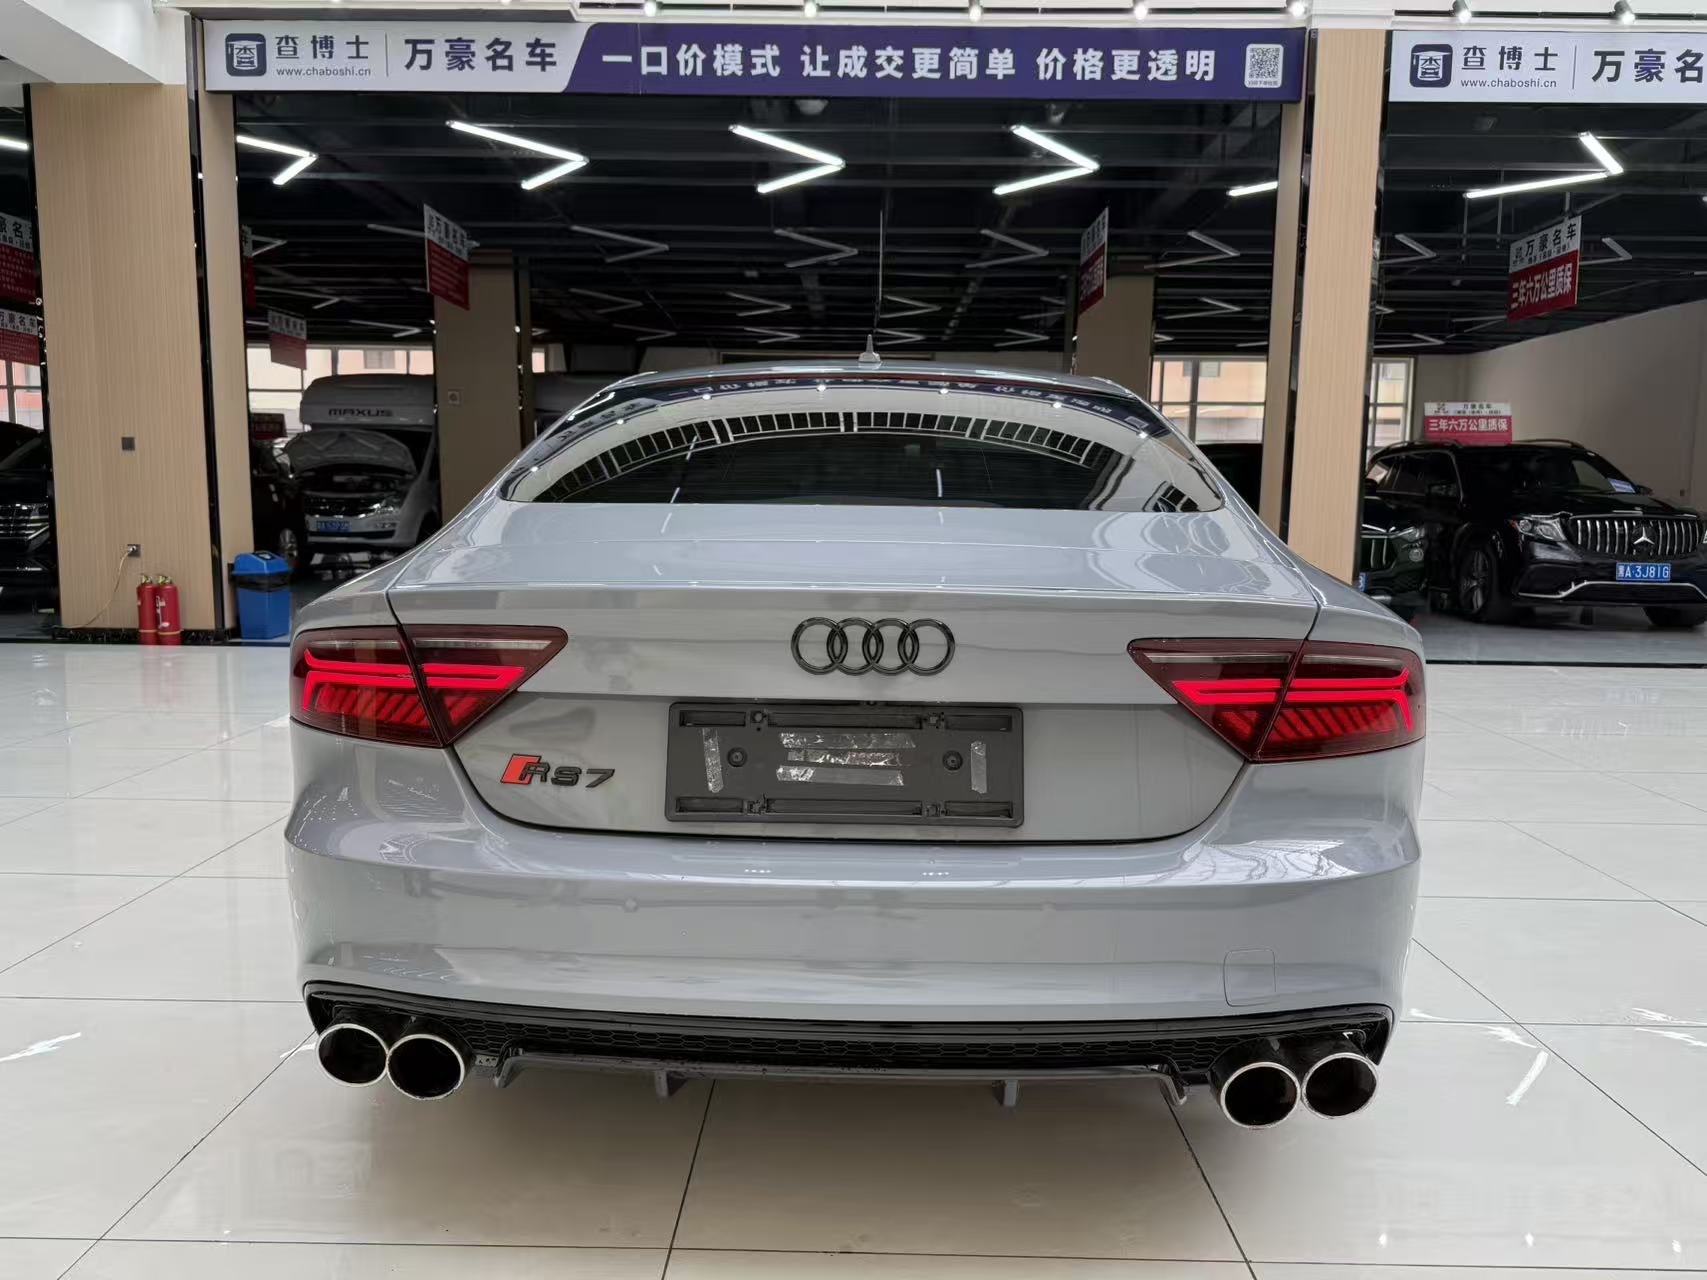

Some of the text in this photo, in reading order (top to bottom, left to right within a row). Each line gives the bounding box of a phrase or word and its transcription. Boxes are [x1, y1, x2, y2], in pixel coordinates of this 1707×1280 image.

[275, 35, 369, 59] 查博士
[404, 38, 557, 72] 万豪名车
[1461, 46, 1558, 71] 查博士
[276, 66, 371, 76] www.chaboshi.cn
[602, 44, 1216, 81] 一口价模式 让成交更简单 价格更透明
[1592, 48, 1704, 83] 万豪名
[1460, 77, 1557, 88] www.chaboshi.cn
[518, 761, 616, 788] RS7
